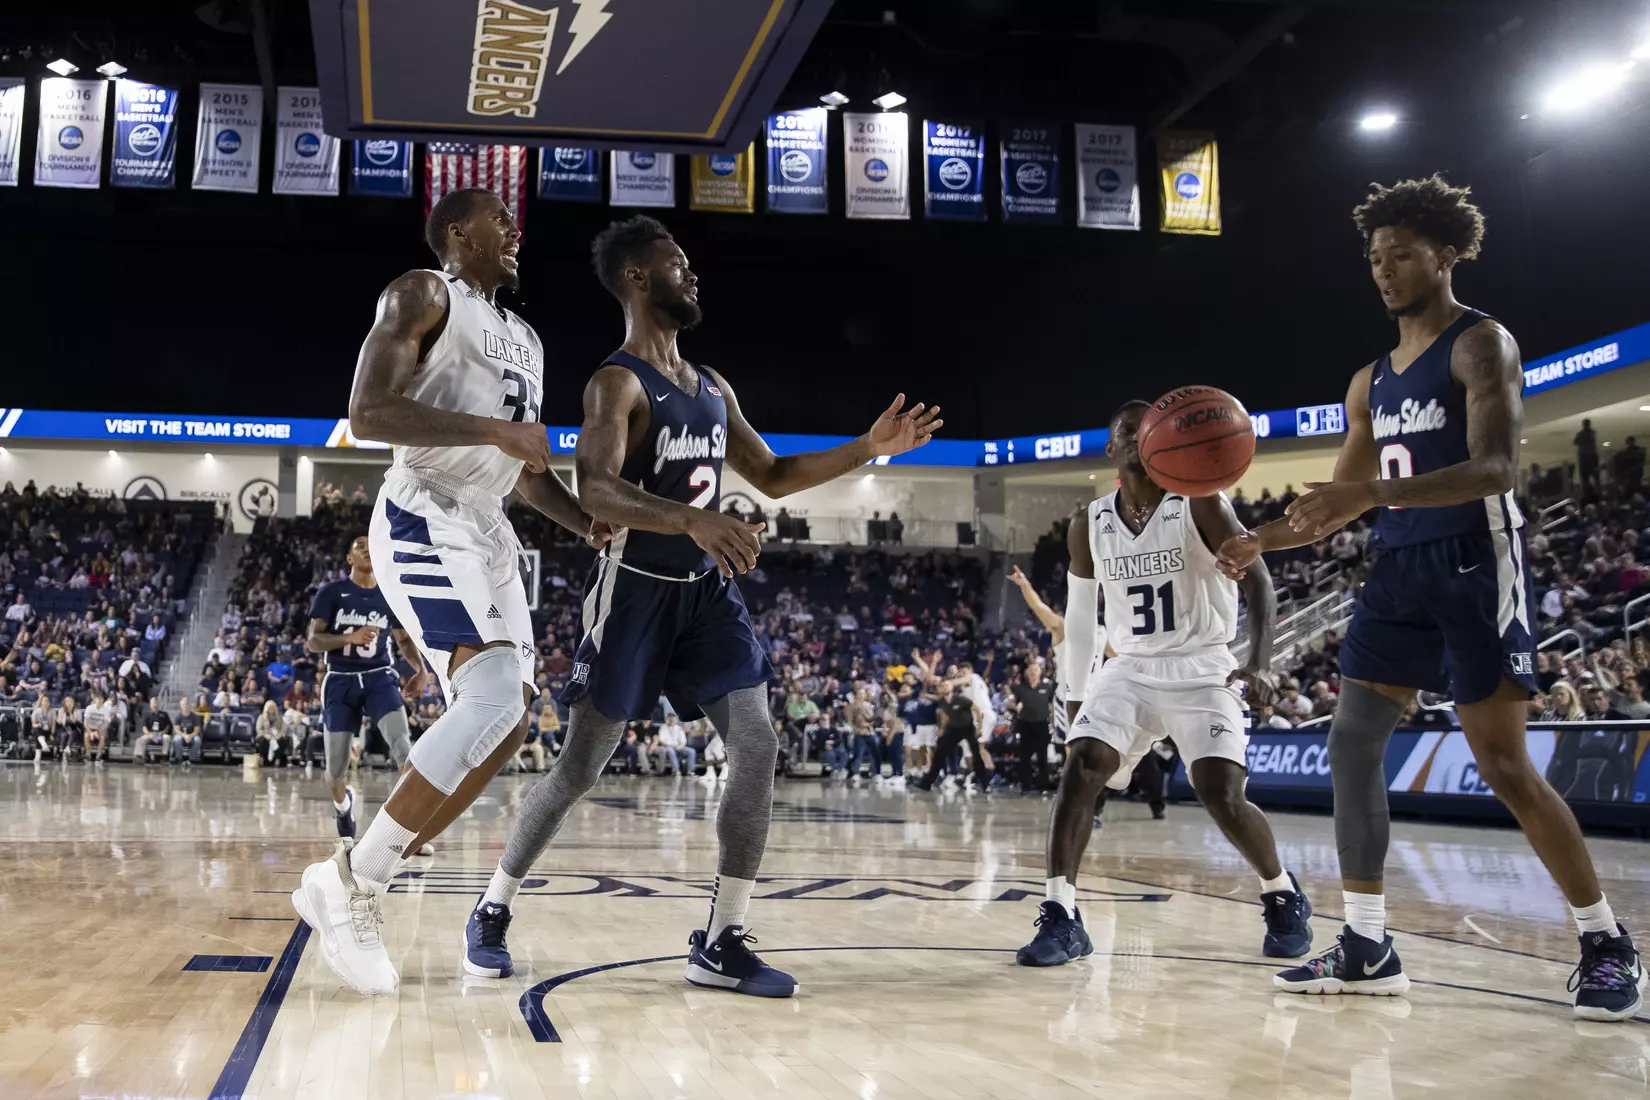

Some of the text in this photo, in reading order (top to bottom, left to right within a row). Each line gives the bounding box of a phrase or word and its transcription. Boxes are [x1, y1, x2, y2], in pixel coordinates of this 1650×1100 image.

[466, 0, 559, 118] ANCERS
[57, 89, 92, 101] 016
[131, 89, 167, 103] 016
[212, 93, 249, 105] 2015
[43, 113, 100, 122] ASKETBALL
[214, 107, 244, 116] MEN'S
[279, 121, 323, 129] BASKETB
[858, 122, 888, 133] 201
[936, 123, 972, 137] 2017
[1013, 129, 1048, 141] 2017
[931, 138, 977, 148] WOMEN'S
[767, 185, 824, 195] CHAMPIONS
[927, 191, 984, 203] CHAMPIONS
[1523, 341, 1619, 388] TEAM STORE!
[1401, 397, 1447, 435] State
[105, 418, 290, 439] VISIT THE TEAM STORE!
[653, 423, 710, 475] Jackson
[1035, 433, 1081, 460] CBU
[688, 464, 717, 510] 2
[1162, 511, 1181, 523] WAC
[1102, 547, 1185, 581] LANCERS
[1126, 580, 1176, 636] 31
[334, 607, 389, 631] Jackson State
